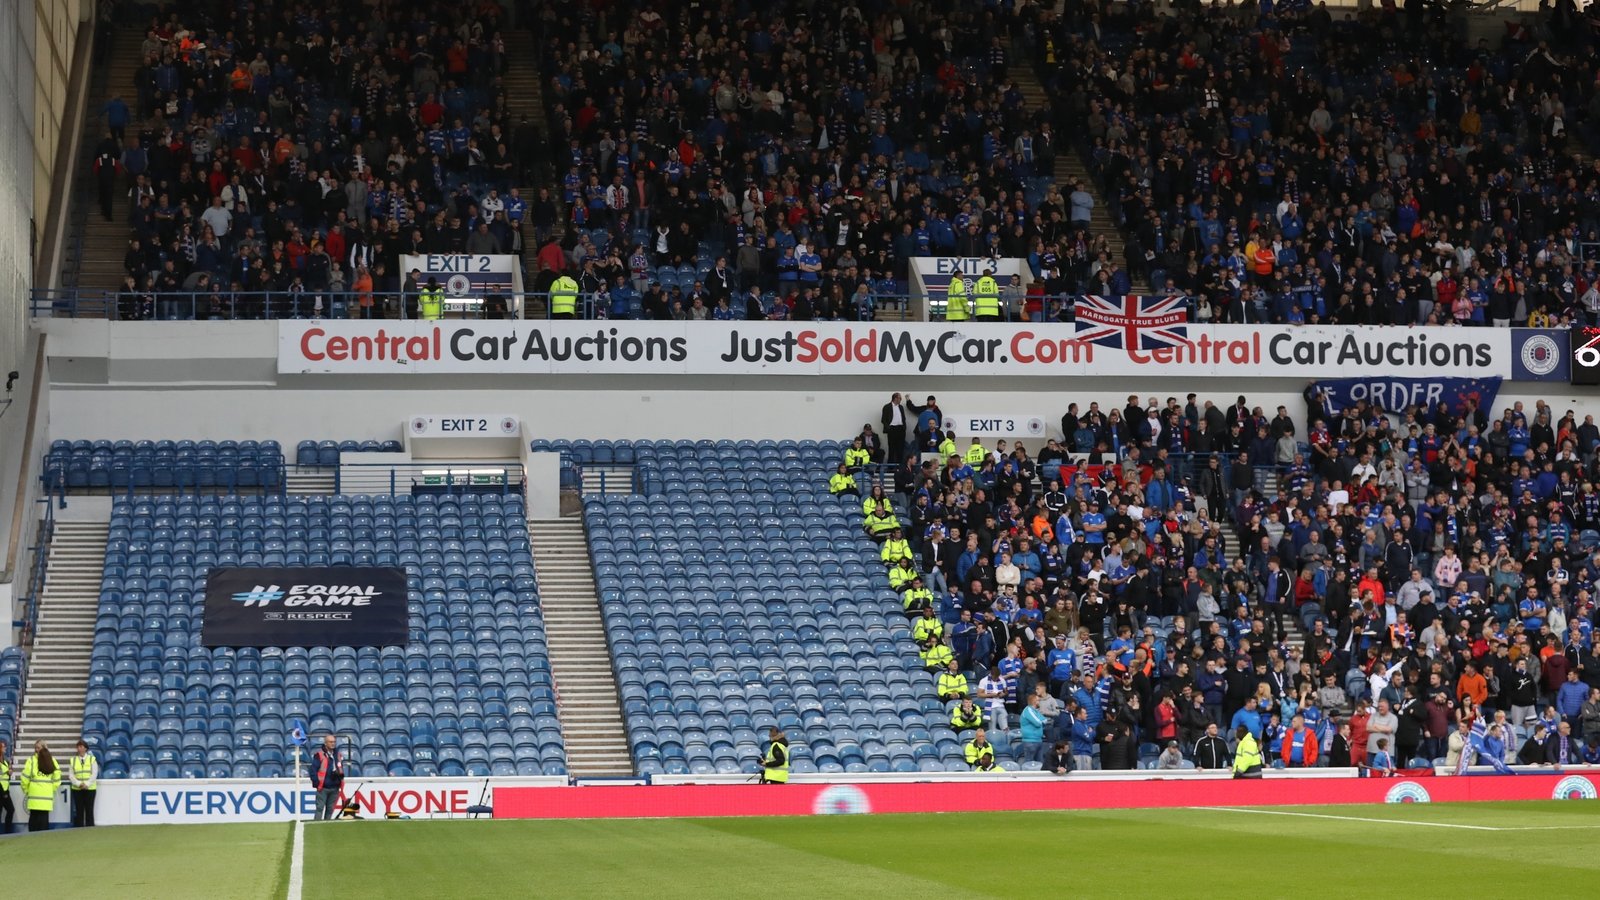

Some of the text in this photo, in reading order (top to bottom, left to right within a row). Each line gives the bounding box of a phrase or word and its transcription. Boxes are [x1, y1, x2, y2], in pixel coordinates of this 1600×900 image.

[427, 256, 491, 272] EXIT 2
[937, 258, 998, 274] EXIT 3
[1082, 309, 1129, 325] HARROGATE
[1154, 314, 1180, 324] BLUES
[300, 327, 688, 362] Central Car Auctions
[1269, 334, 1332, 365] Car
[1336, 334, 1492, 367] Auctions
[441, 420, 487, 431] EXIT 2
[970, 420, 1014, 431] EXIT 3
[289, 585, 382, 596] EQUAL
[284, 595, 373, 607] GAME
[61, 788, 67, 803] 1
[141, 791, 316, 815] EVERYONE
